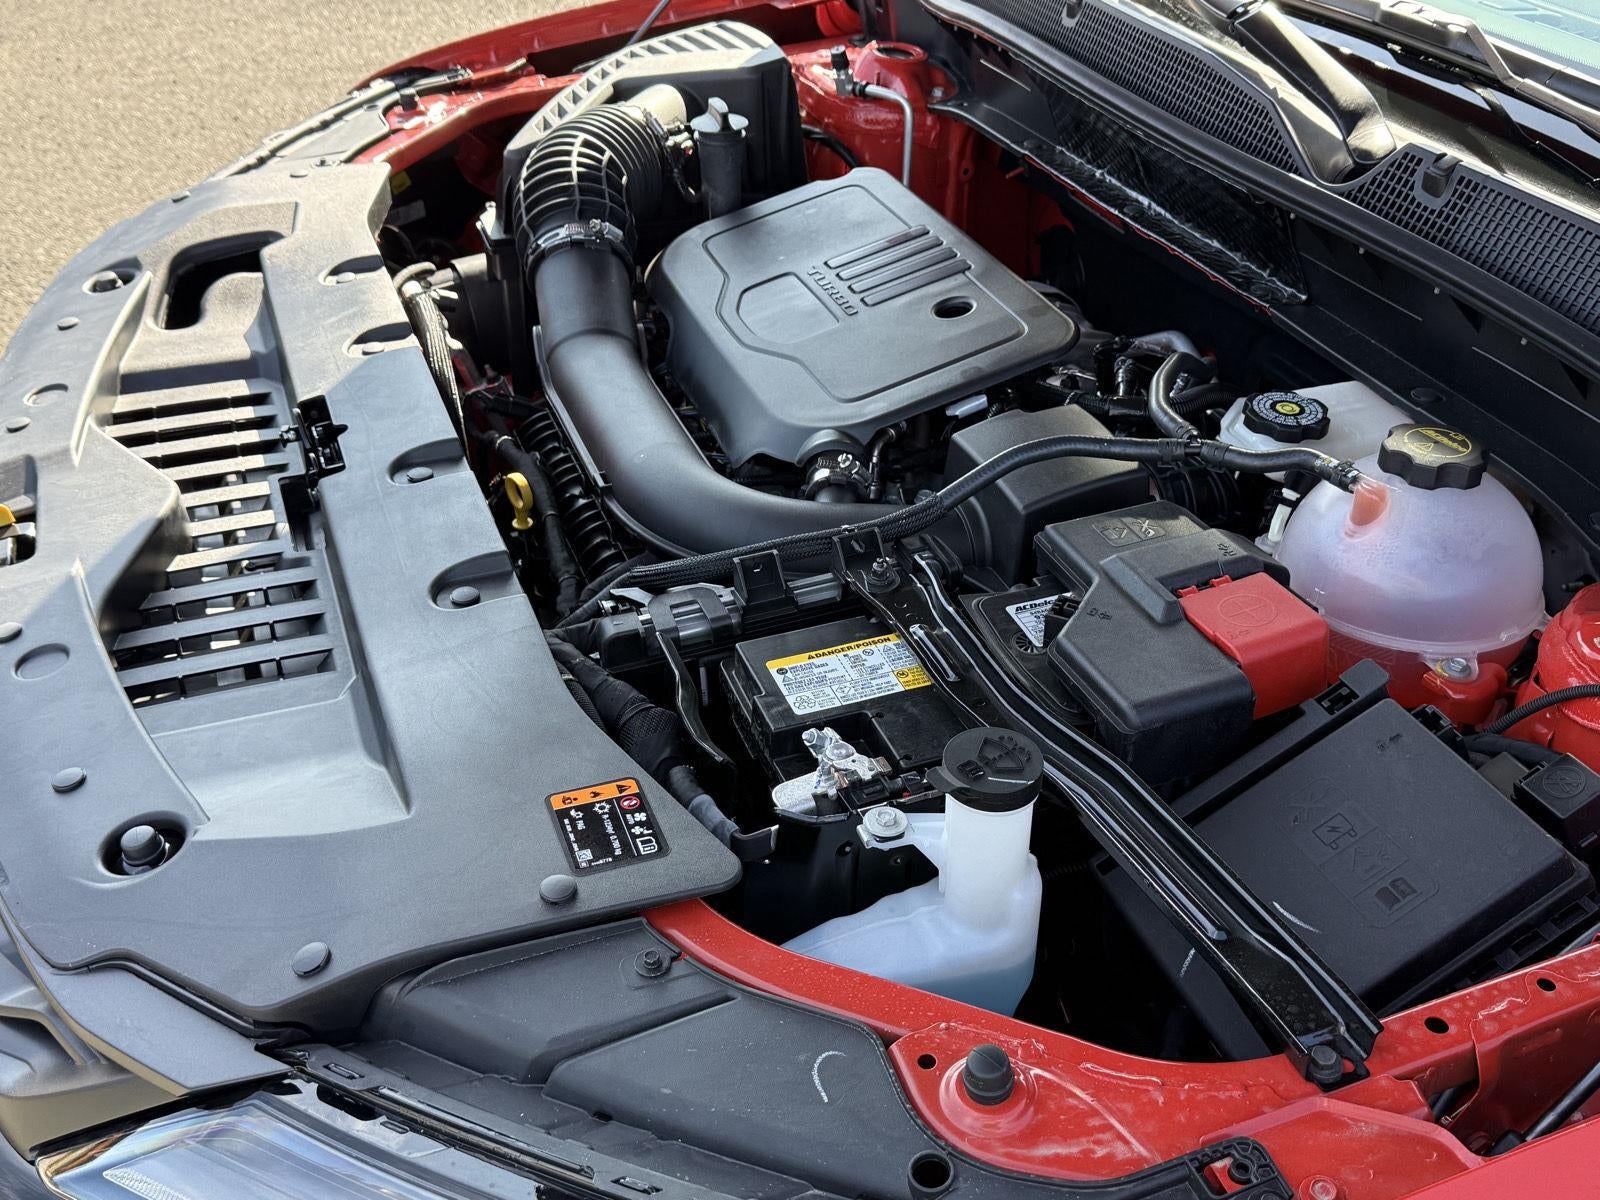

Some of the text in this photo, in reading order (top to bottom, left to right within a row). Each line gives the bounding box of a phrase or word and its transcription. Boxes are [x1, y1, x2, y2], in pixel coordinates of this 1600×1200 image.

[806, 265, 859, 317] TURBO
[814, 636, 892, 660] DANGER/POISON
[575, 819, 586, 831] PAG
